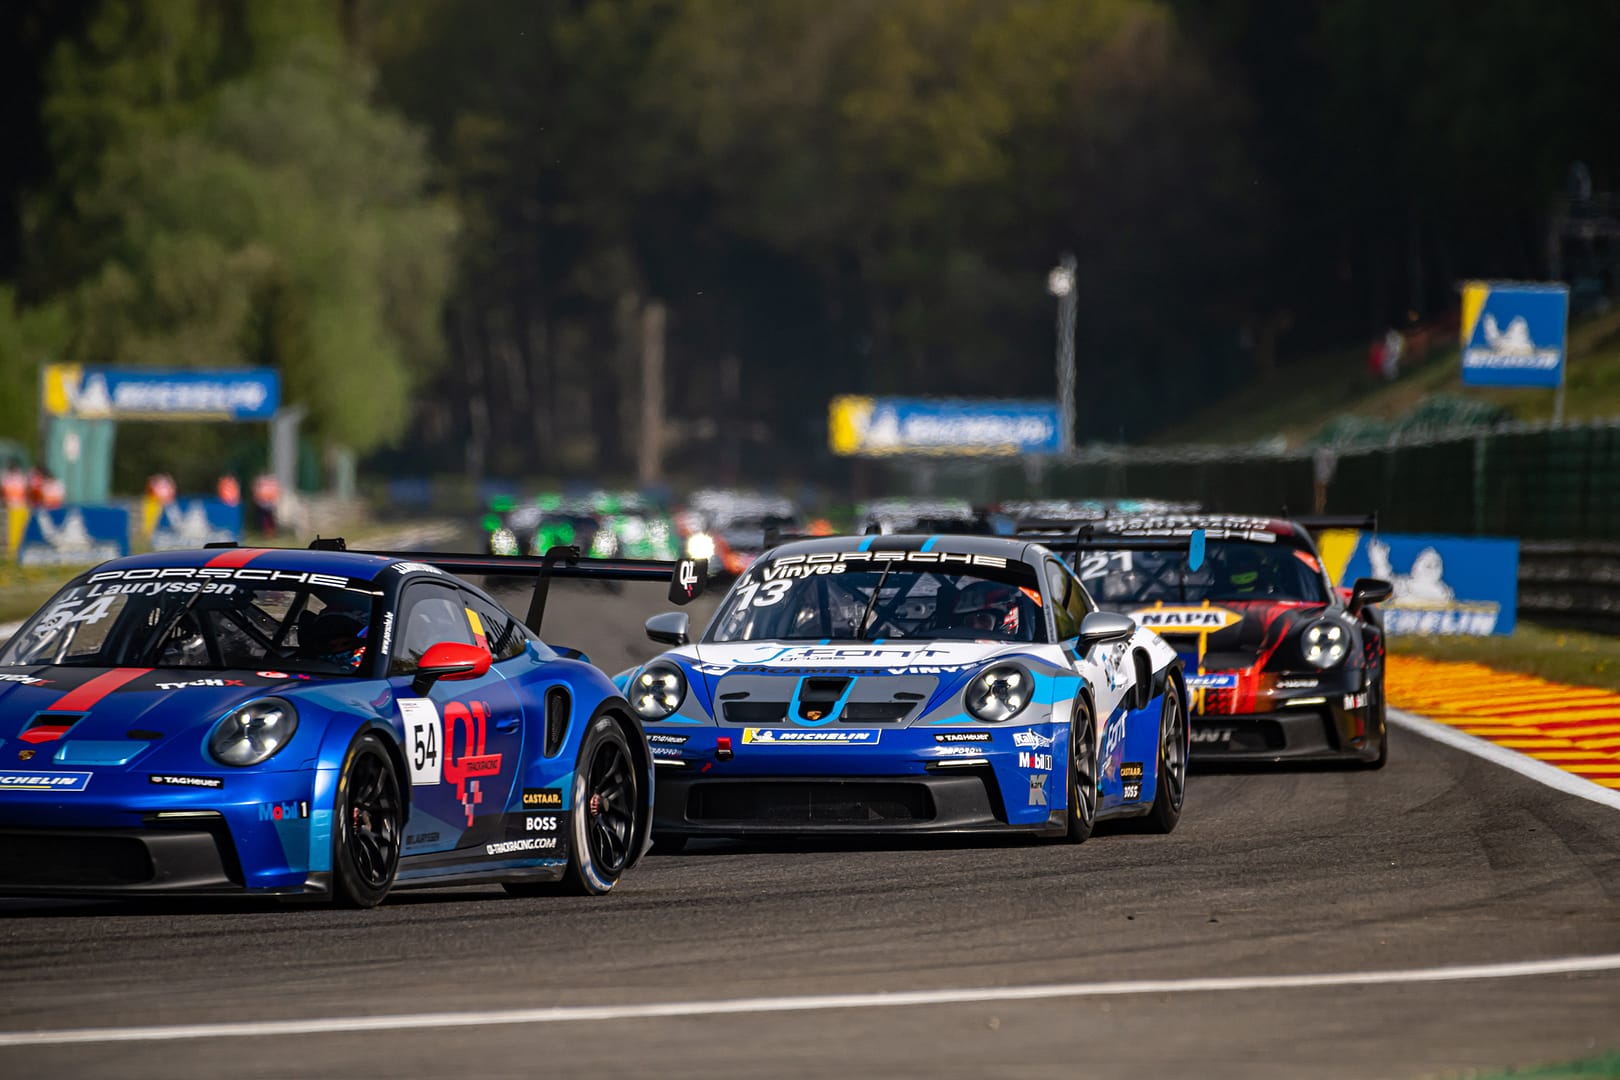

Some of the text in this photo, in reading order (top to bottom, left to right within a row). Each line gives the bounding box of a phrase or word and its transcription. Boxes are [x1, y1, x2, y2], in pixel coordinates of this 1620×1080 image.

[774, 551, 1006, 569] PORSCHE
[1080, 549, 1133, 581] 21
[87, 567, 349, 589] PORSCHE
[763, 562, 848, 582] Vinyes
[86, 582, 237, 597] Lauryssen
[736, 579, 793, 611] 13
[34, 595, 117, 639] 54
[1140, 613, 1221, 625] NAPA
[780, 732, 870, 740] MICHELIN
[413, 722, 437, 771] 54
[1019, 752, 1044, 770] Mobil
[0, 776, 78, 786] CHELIN
[523, 793, 561, 805] CASTAAR.
[258, 801, 308, 821] Mobil 1
[526, 817, 557, 831] BOSS
